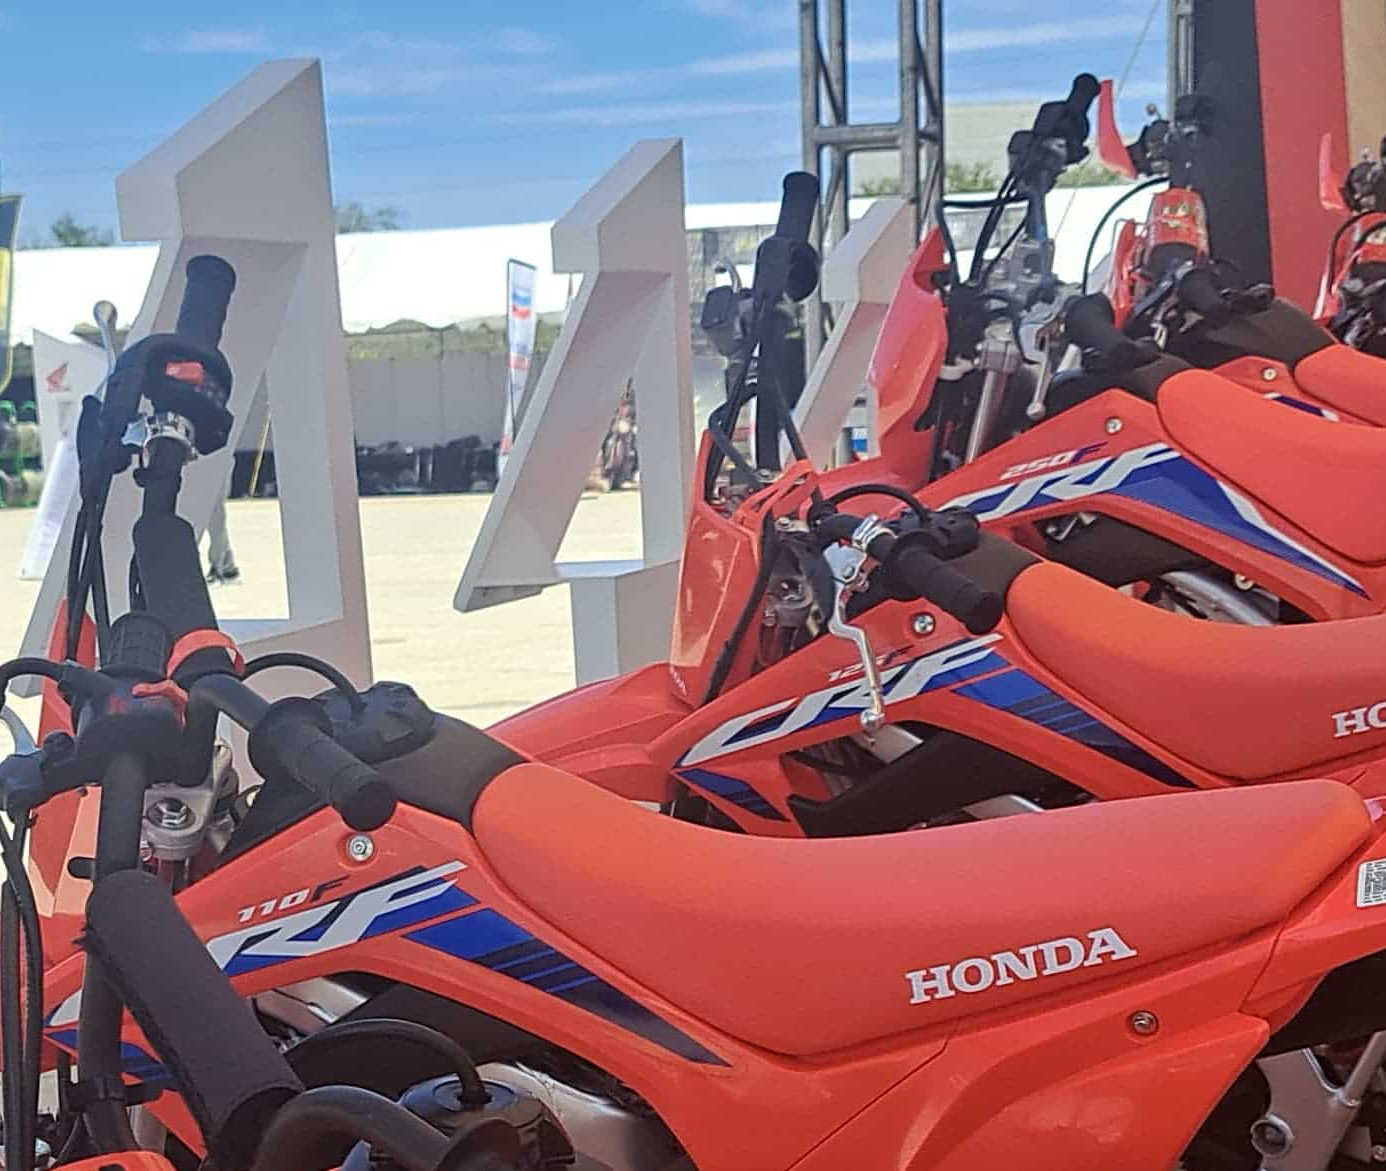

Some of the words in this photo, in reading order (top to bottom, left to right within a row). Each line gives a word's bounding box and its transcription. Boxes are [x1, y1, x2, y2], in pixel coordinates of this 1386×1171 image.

[999, 441, 1109, 480] 250F
[677, 633, 1003, 767] CRF
[237, 875, 350, 923] 110F
[906, 927, 1137, 1006] HONDA
